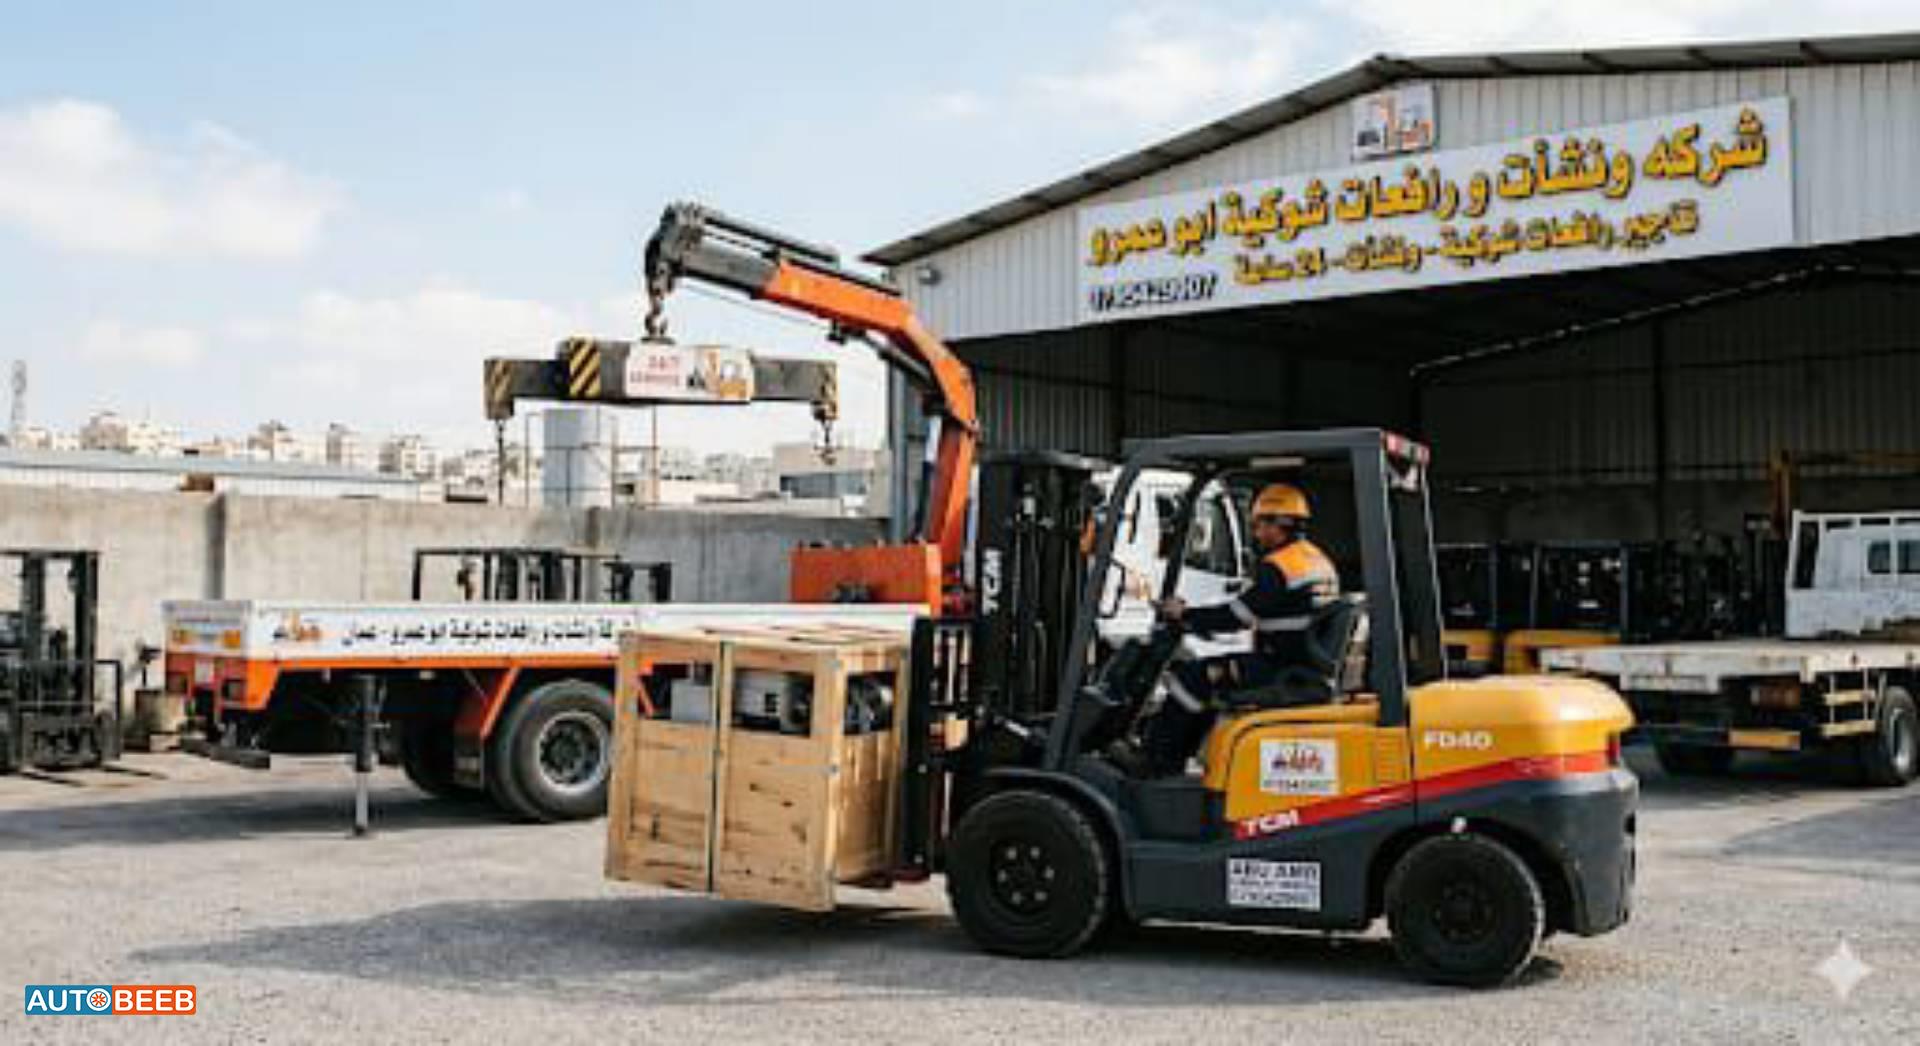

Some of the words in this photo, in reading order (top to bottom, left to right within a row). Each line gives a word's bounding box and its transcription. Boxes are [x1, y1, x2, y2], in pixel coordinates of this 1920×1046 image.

[1222, 178, 1328, 248] شوكية
[1334, 163, 1460, 222] رافعات
[981, 547, 1002, 616] TCM
[1423, 730, 1493, 749] FD40
[1240, 809, 1299, 838] TCM
